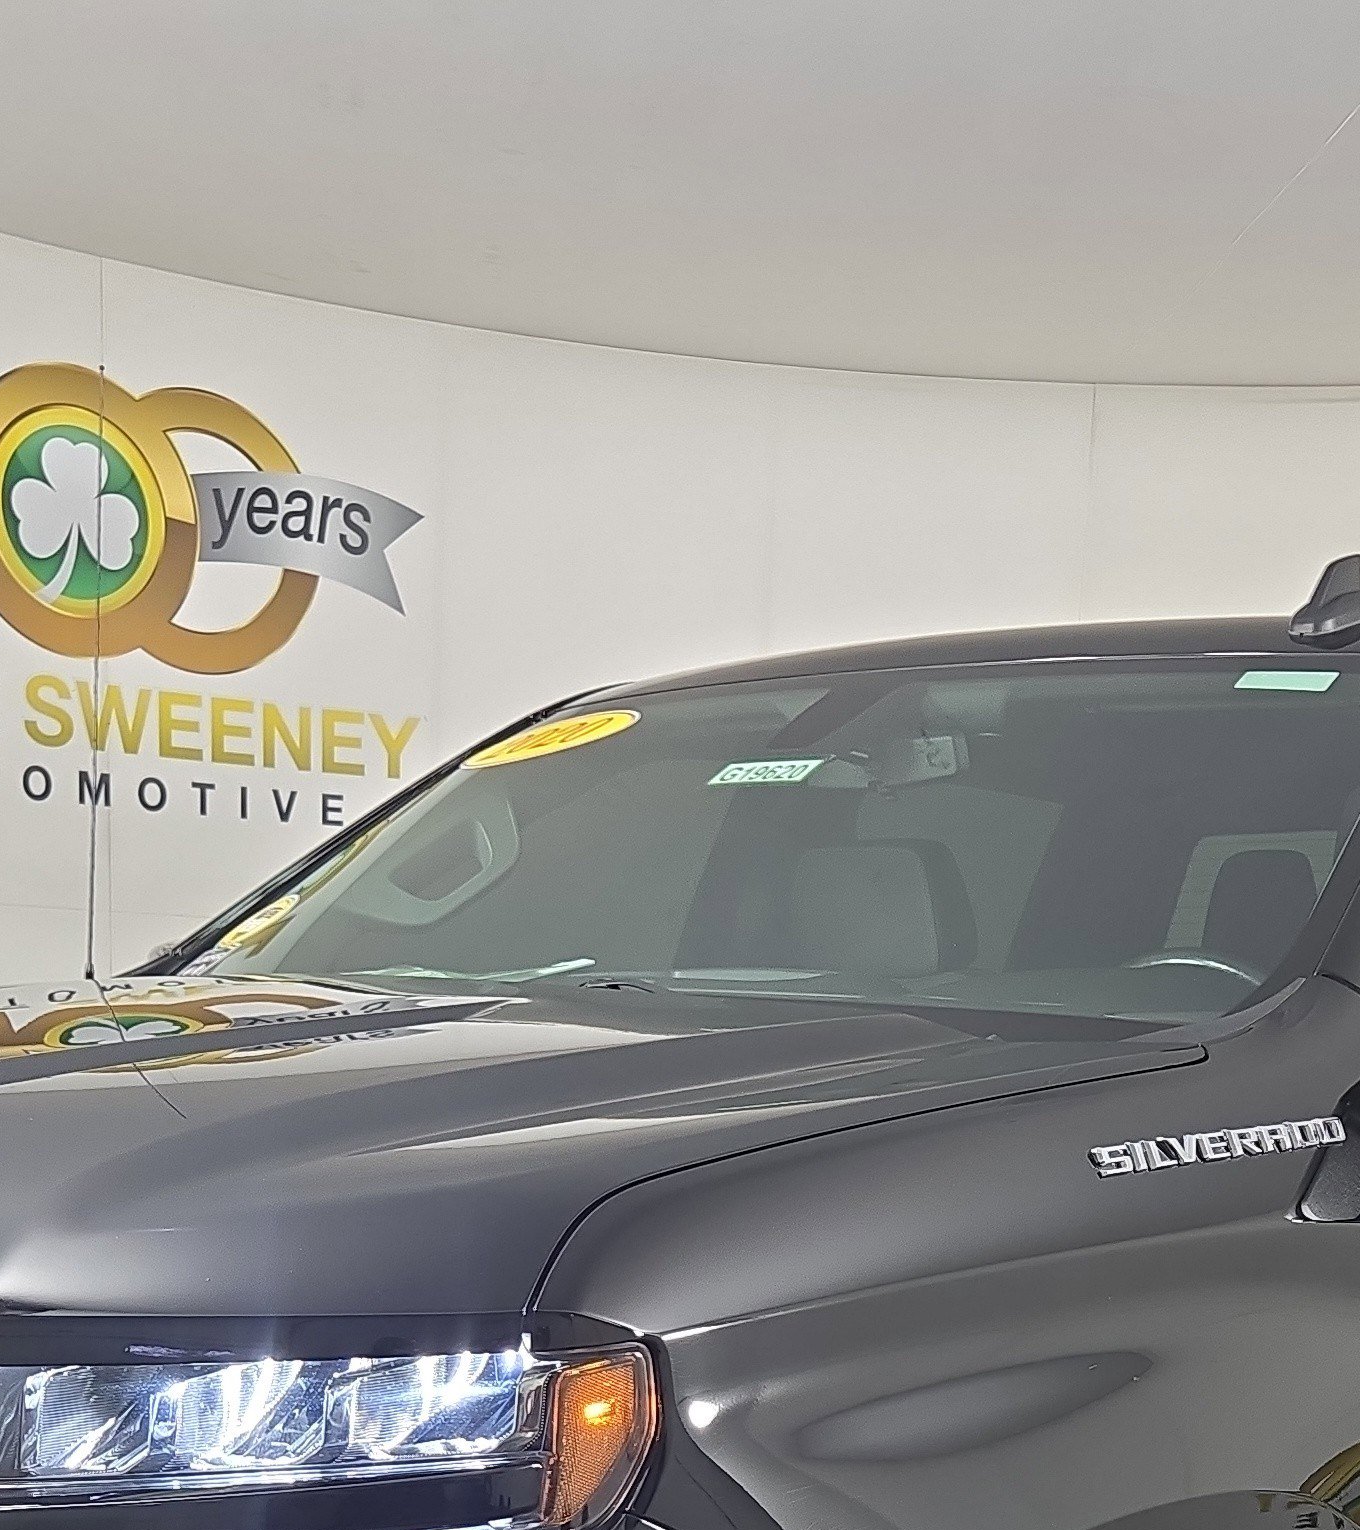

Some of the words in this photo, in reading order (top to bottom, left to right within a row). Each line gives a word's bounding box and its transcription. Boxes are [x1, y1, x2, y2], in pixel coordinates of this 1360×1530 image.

[211, 486, 371, 557] years
[23, 675, 421, 779] SWEENEY
[719, 765, 810, 782] G19620
[1089, 1116, 1346, 1178] SILVERADO
